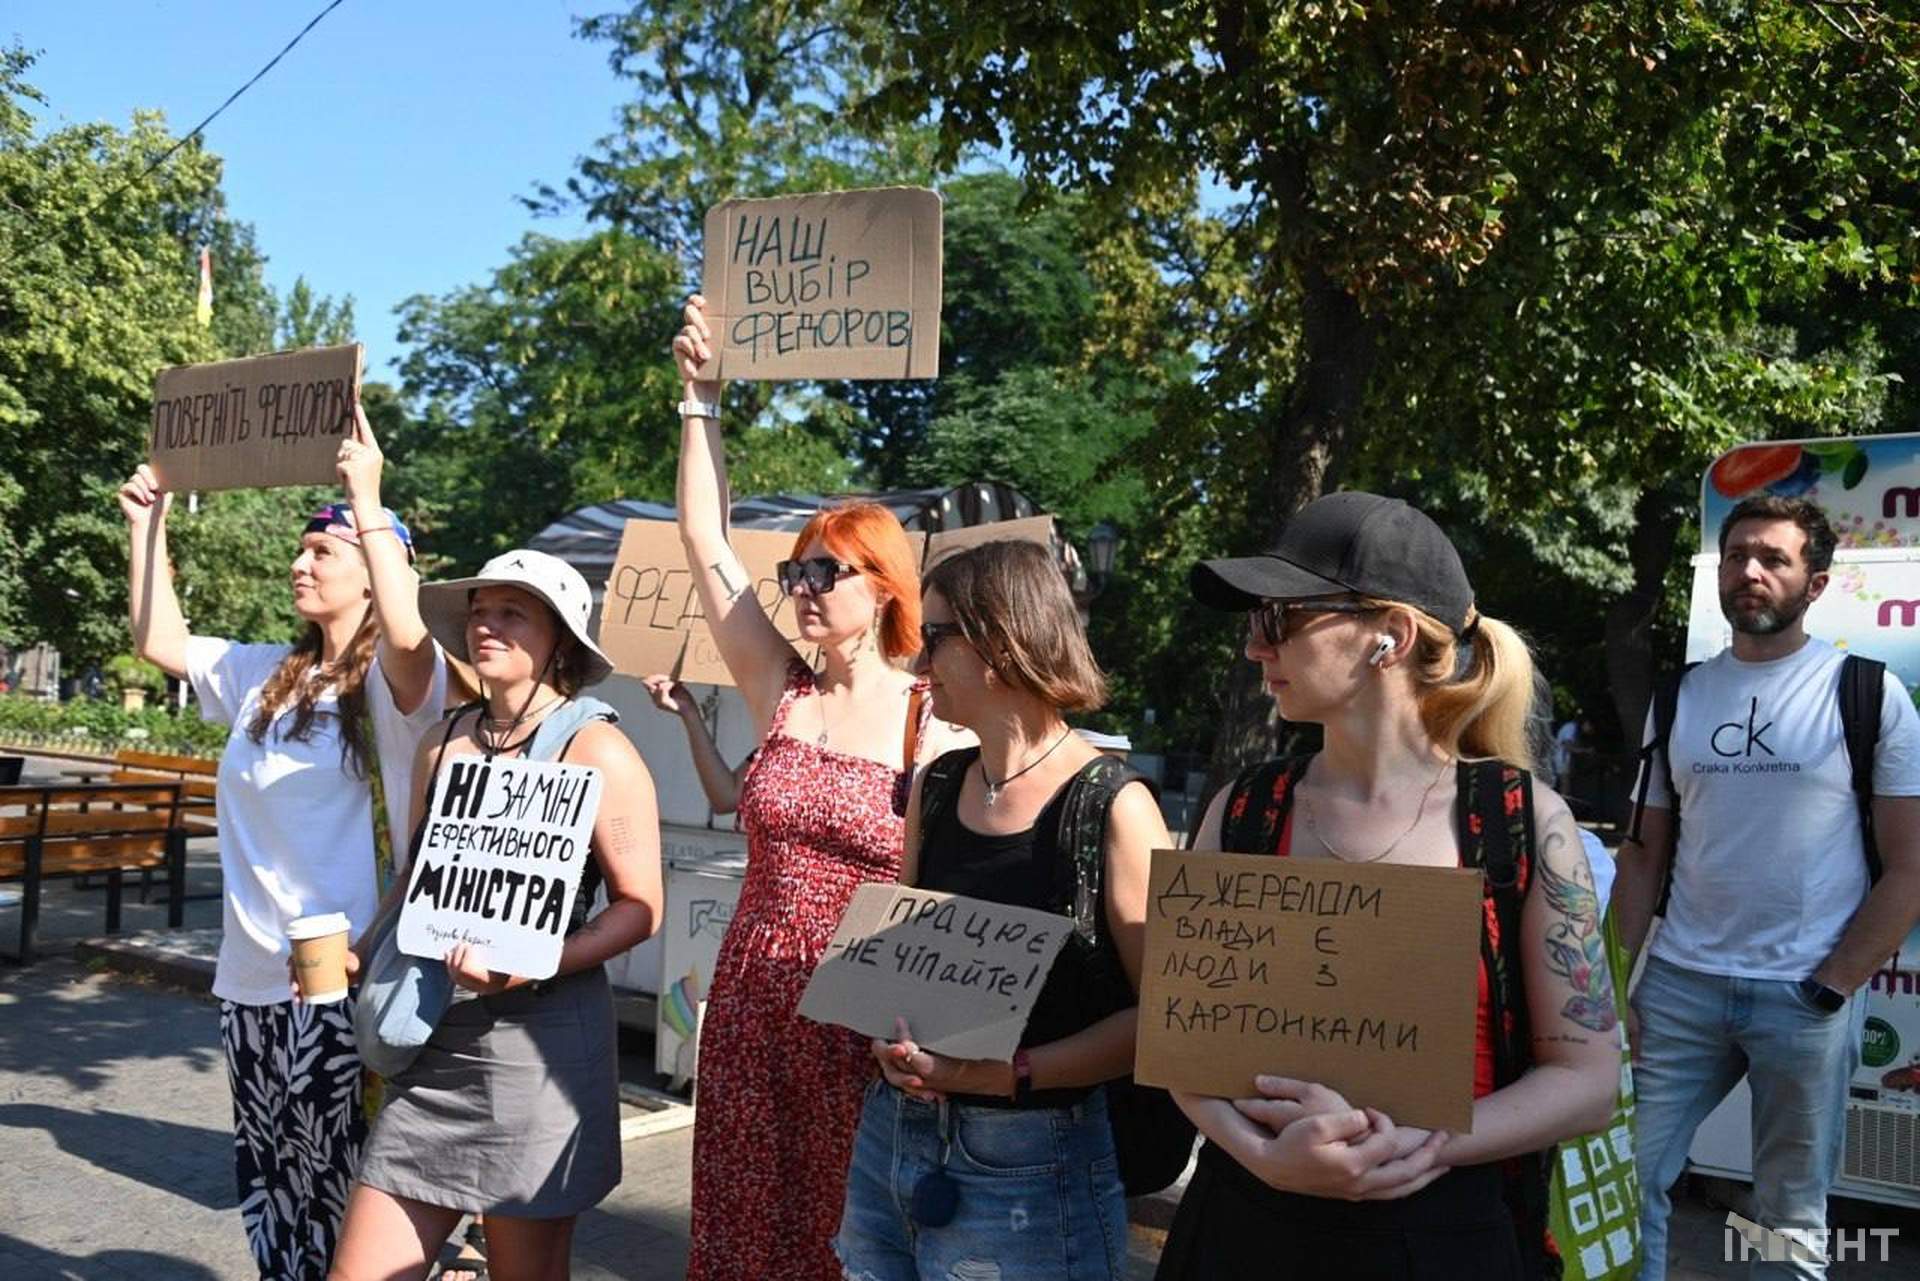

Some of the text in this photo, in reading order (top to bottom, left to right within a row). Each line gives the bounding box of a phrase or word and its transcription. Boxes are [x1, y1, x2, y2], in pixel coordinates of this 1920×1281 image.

[733, 214, 827, 266] НАШ
[732, 306, 911, 364] ФЕДОРОВ
[258, 376, 355, 445] ФЕДОРОВА
[440, 754, 594, 827] НІ ЗАМІНІ
[1732, 761, 1801, 775] Konkretna
[427, 822, 575, 862] ЕФЕКТИВНОГО
[408, 853, 566, 935] МІНІСТРА
[1157, 863, 1382, 918] ДЖЕРЕЛОМ
[889, 897, 1050, 954] ПРАЦЮЄ
[1176, 916, 1276, 950] ВЛАДИ
[1162, 951, 1269, 988] ЛЮДИ
[1164, 996, 1419, 1051] КАРТОНКАМИ
